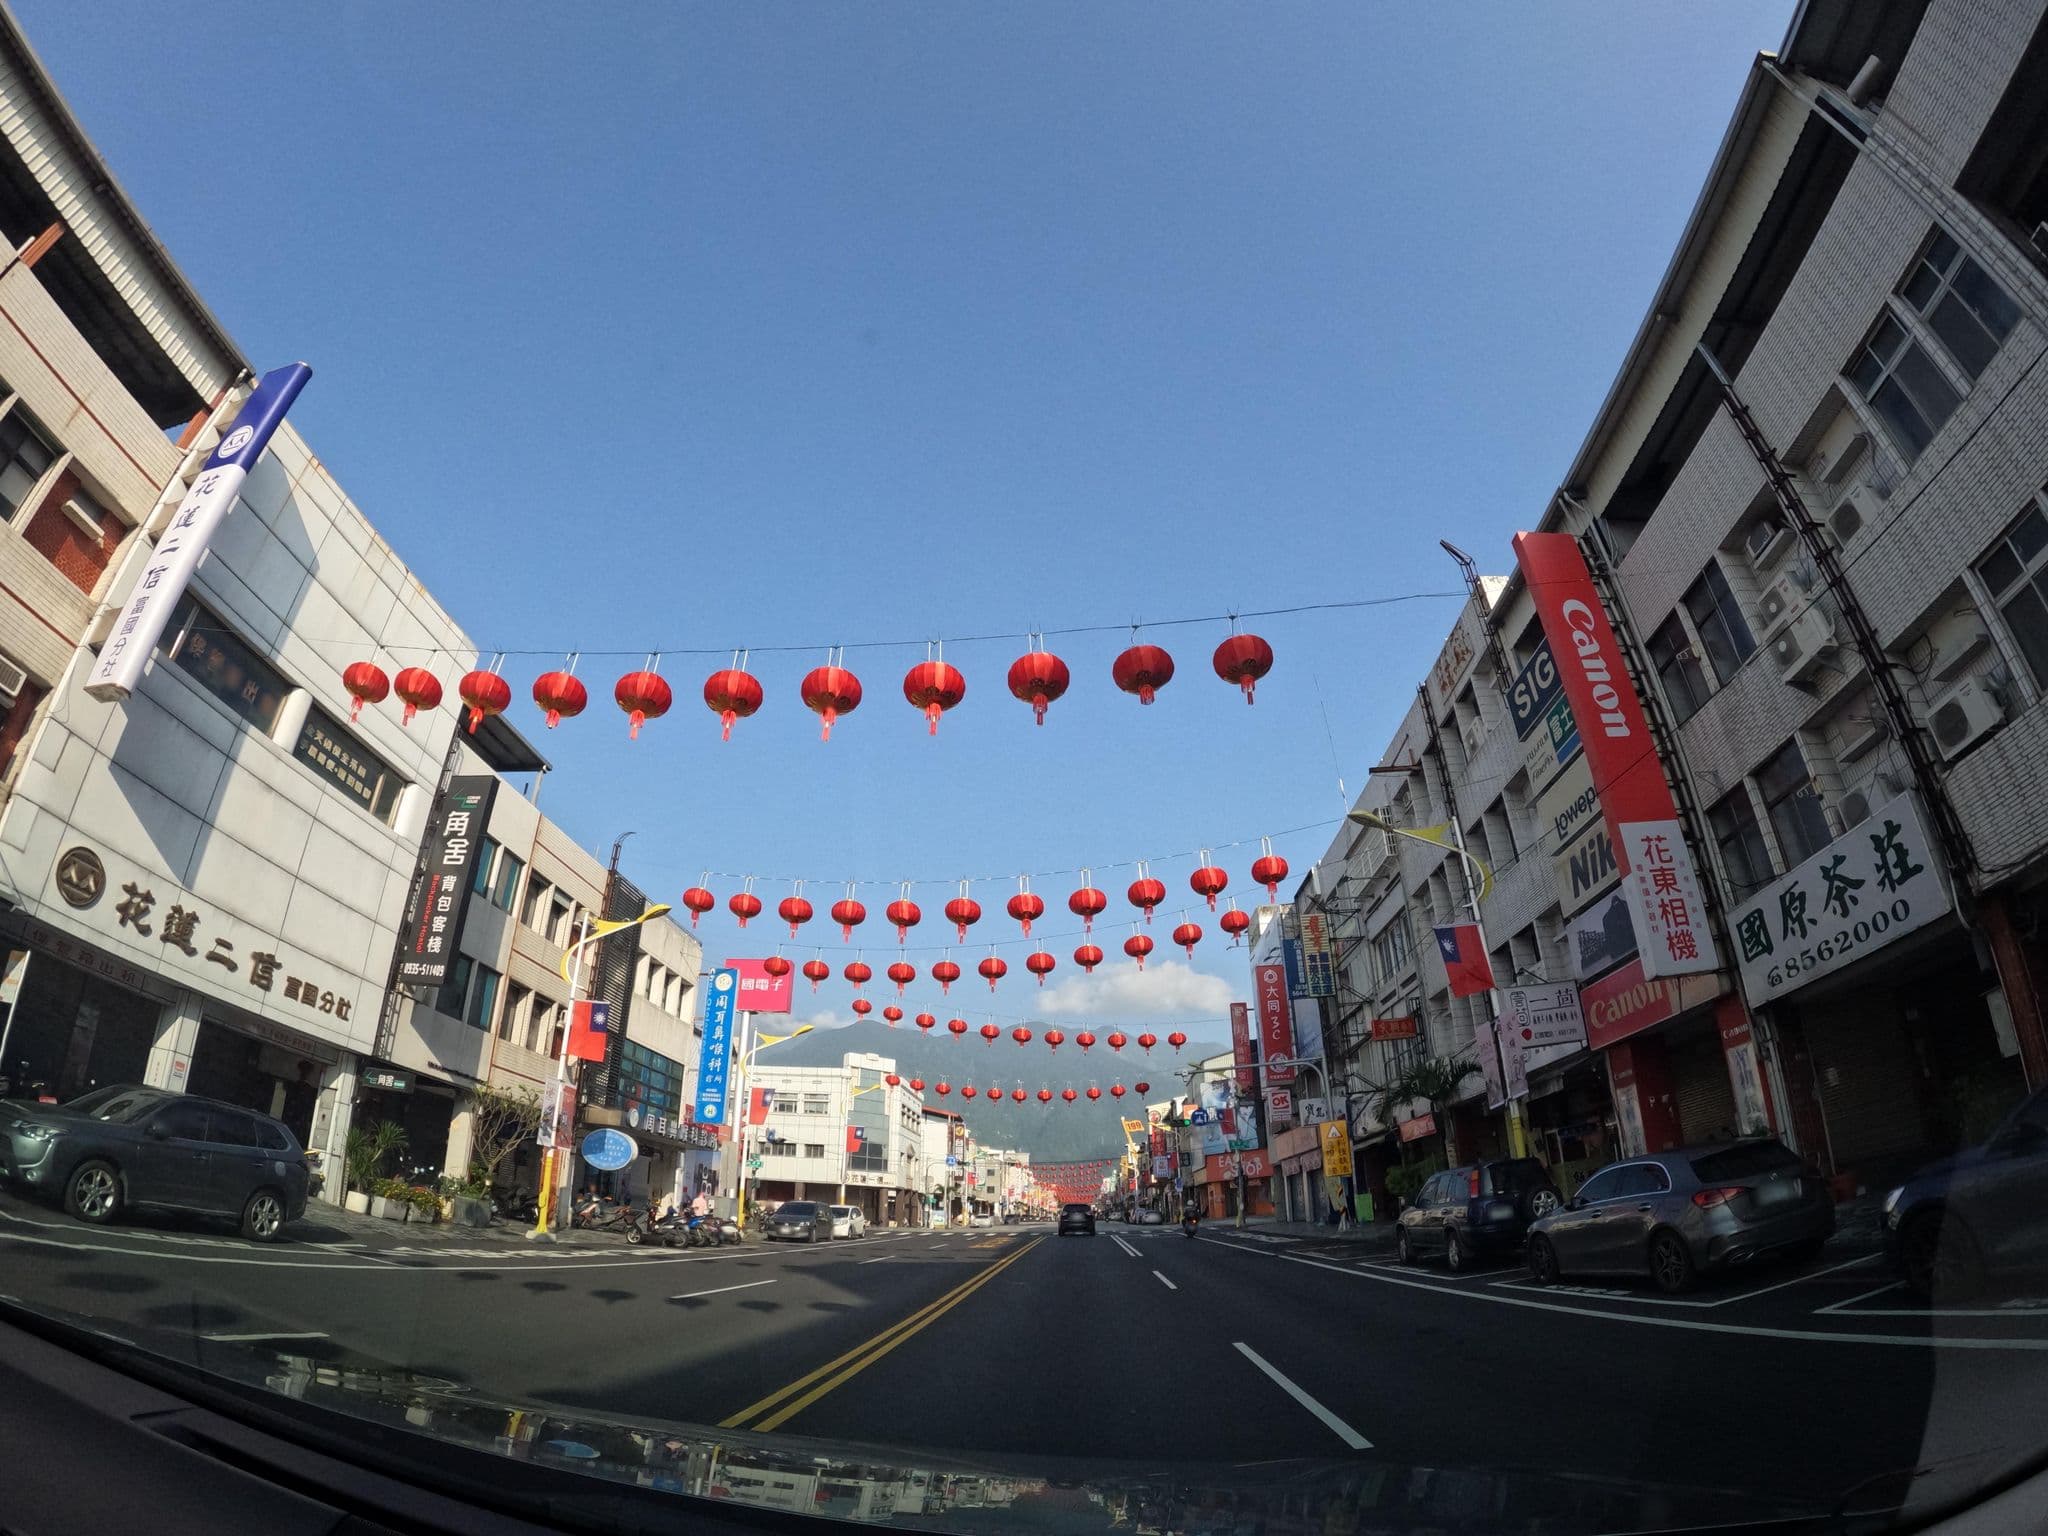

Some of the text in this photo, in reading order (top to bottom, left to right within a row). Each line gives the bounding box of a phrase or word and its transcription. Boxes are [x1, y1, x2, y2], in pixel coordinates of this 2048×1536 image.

[1562, 599, 1631, 737] Canon
[1526, 731, 1549, 763] FUJIFILM
[1550, 703, 1574, 744] 富士
[442, 811, 471, 865] 角舍
[1554, 784, 1599, 841] Lowep
[1570, 832, 1617, 899] Nik
[1736, 820, 1924, 963] 國原茶莊
[415, 873, 441, 953] Backpacker Hostel
[427, 875, 457, 953] 背包客棧
[1641, 835, 1699, 961] 花東相機
[115, 881, 352, 1021] 花蓮二信 富國分社
[1785, 899, 1911, 979] 8562000
[741, 978, 783, 991] 國電子
[1266, 986, 1281, 1040] 大同3C
[1589, 981, 1664, 1029] Canon
[708, 995, 728, 1072] 周耳鼻喉科
[1723, 1023, 1749, 1040] Canon
[1273, 1095, 1289, 1107] OK
